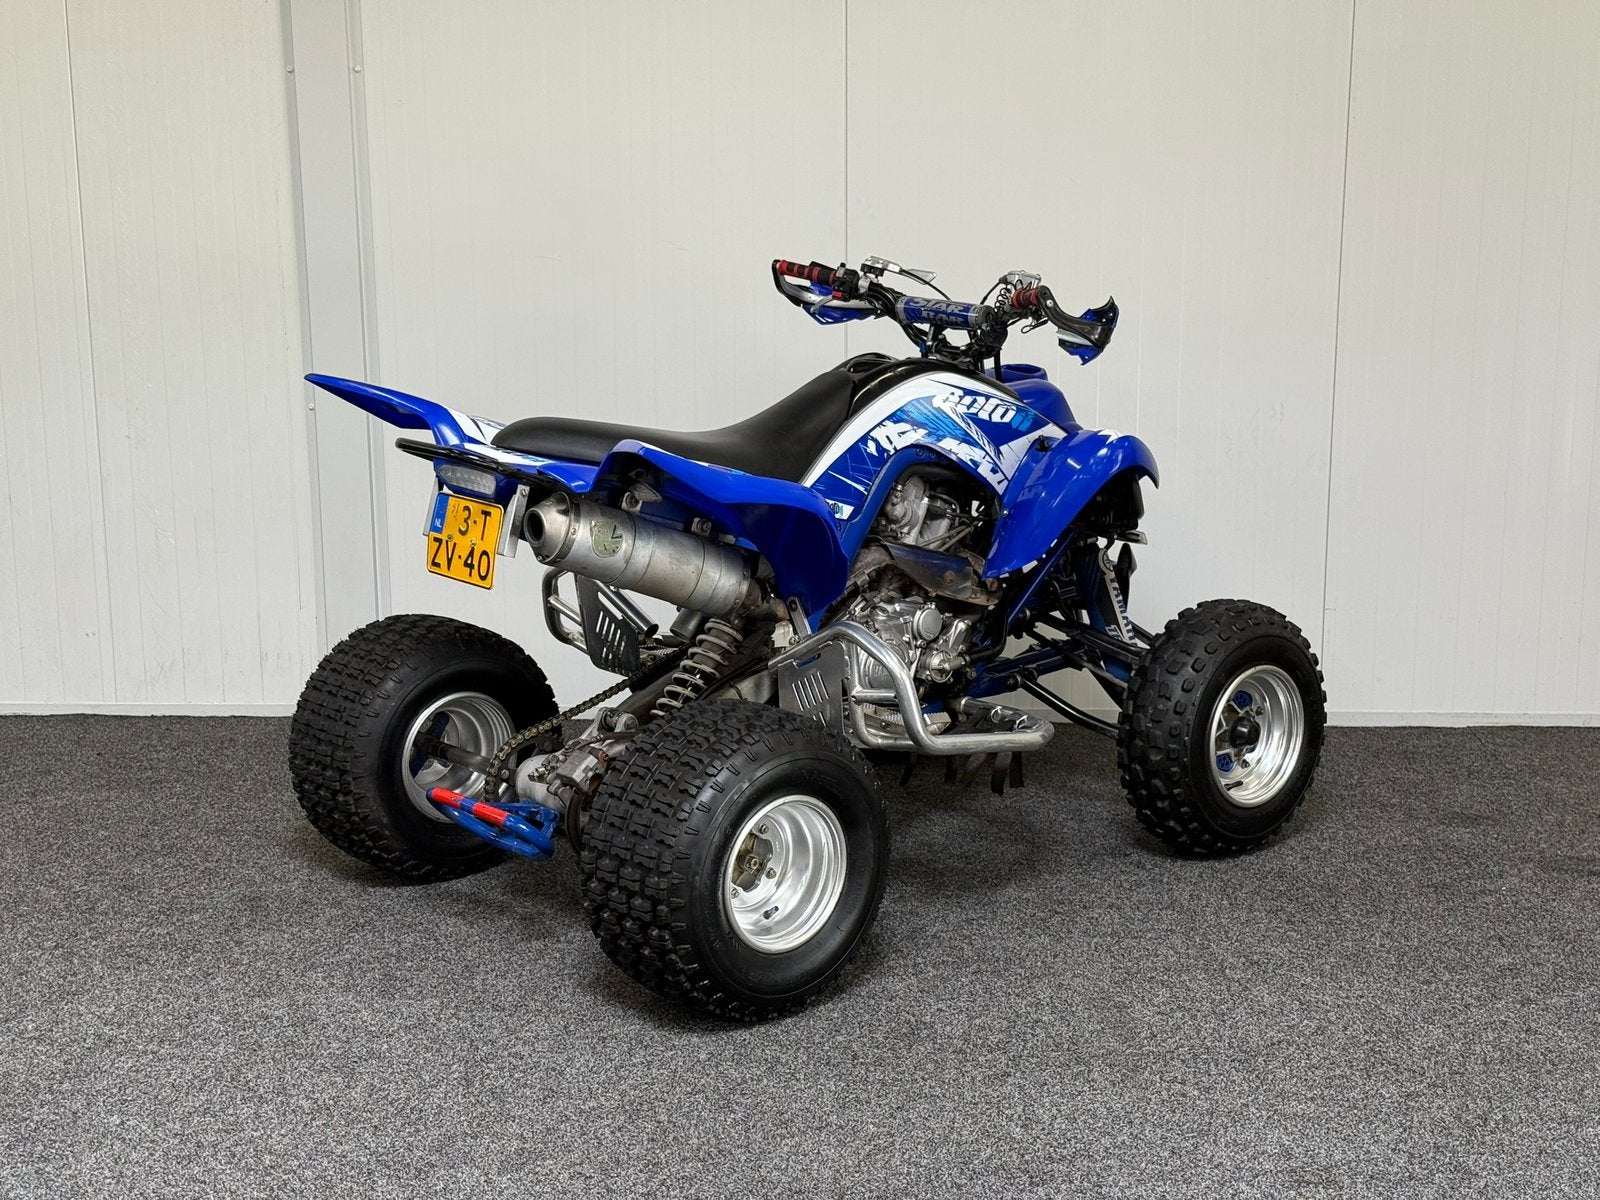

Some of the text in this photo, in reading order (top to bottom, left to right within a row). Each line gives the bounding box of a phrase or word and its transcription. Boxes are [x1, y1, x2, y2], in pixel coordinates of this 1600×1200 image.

[434, 517, 442, 528] NL
[457, 505, 492, 541] 3-T
[431, 536, 491, 582] ZV-40
